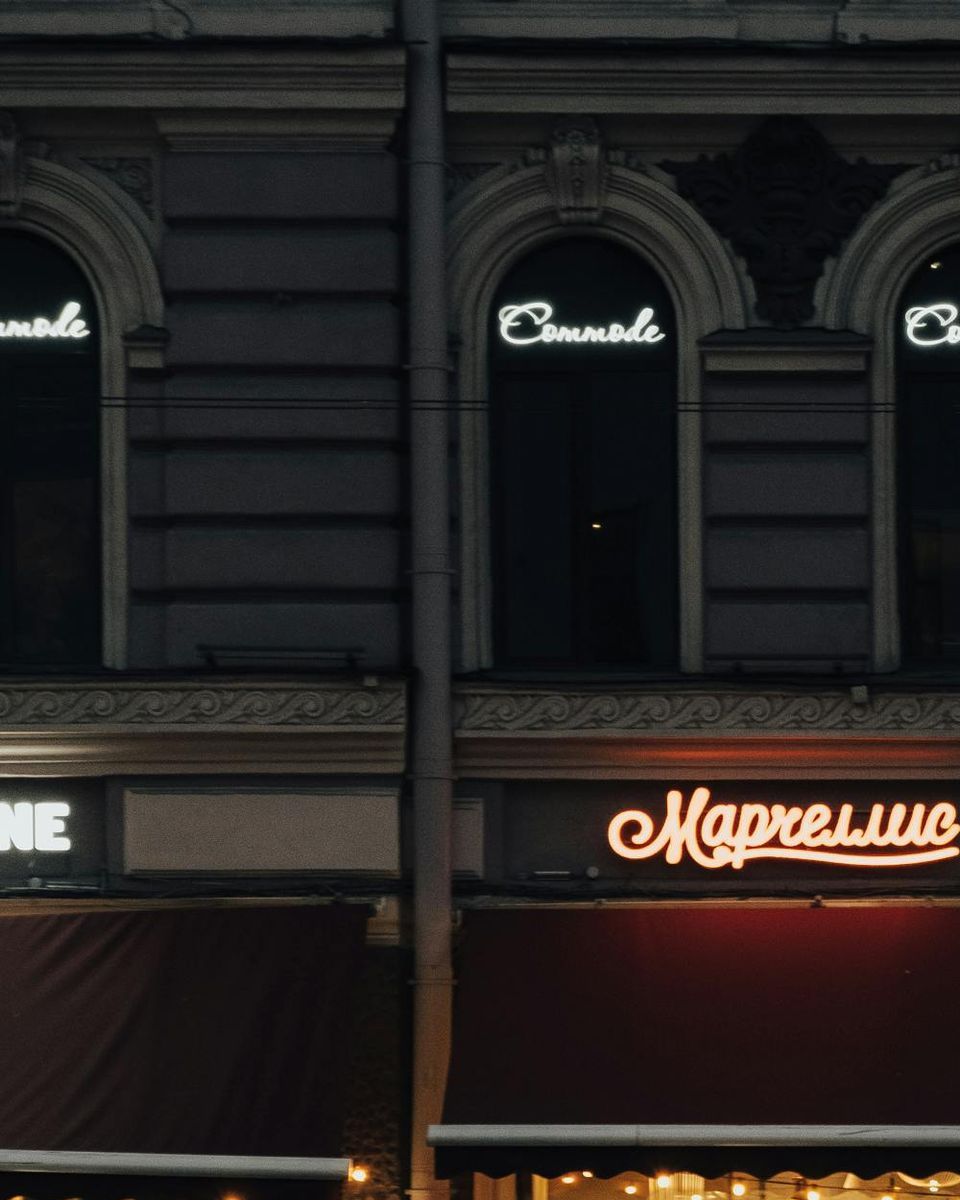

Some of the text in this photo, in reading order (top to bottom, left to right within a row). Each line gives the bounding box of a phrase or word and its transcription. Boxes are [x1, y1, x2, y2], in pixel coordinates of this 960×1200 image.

[498, 301, 666, 345] Commode
[0, 801, 71, 851] NE
[608, 787, 960, 869] Марчеллис
